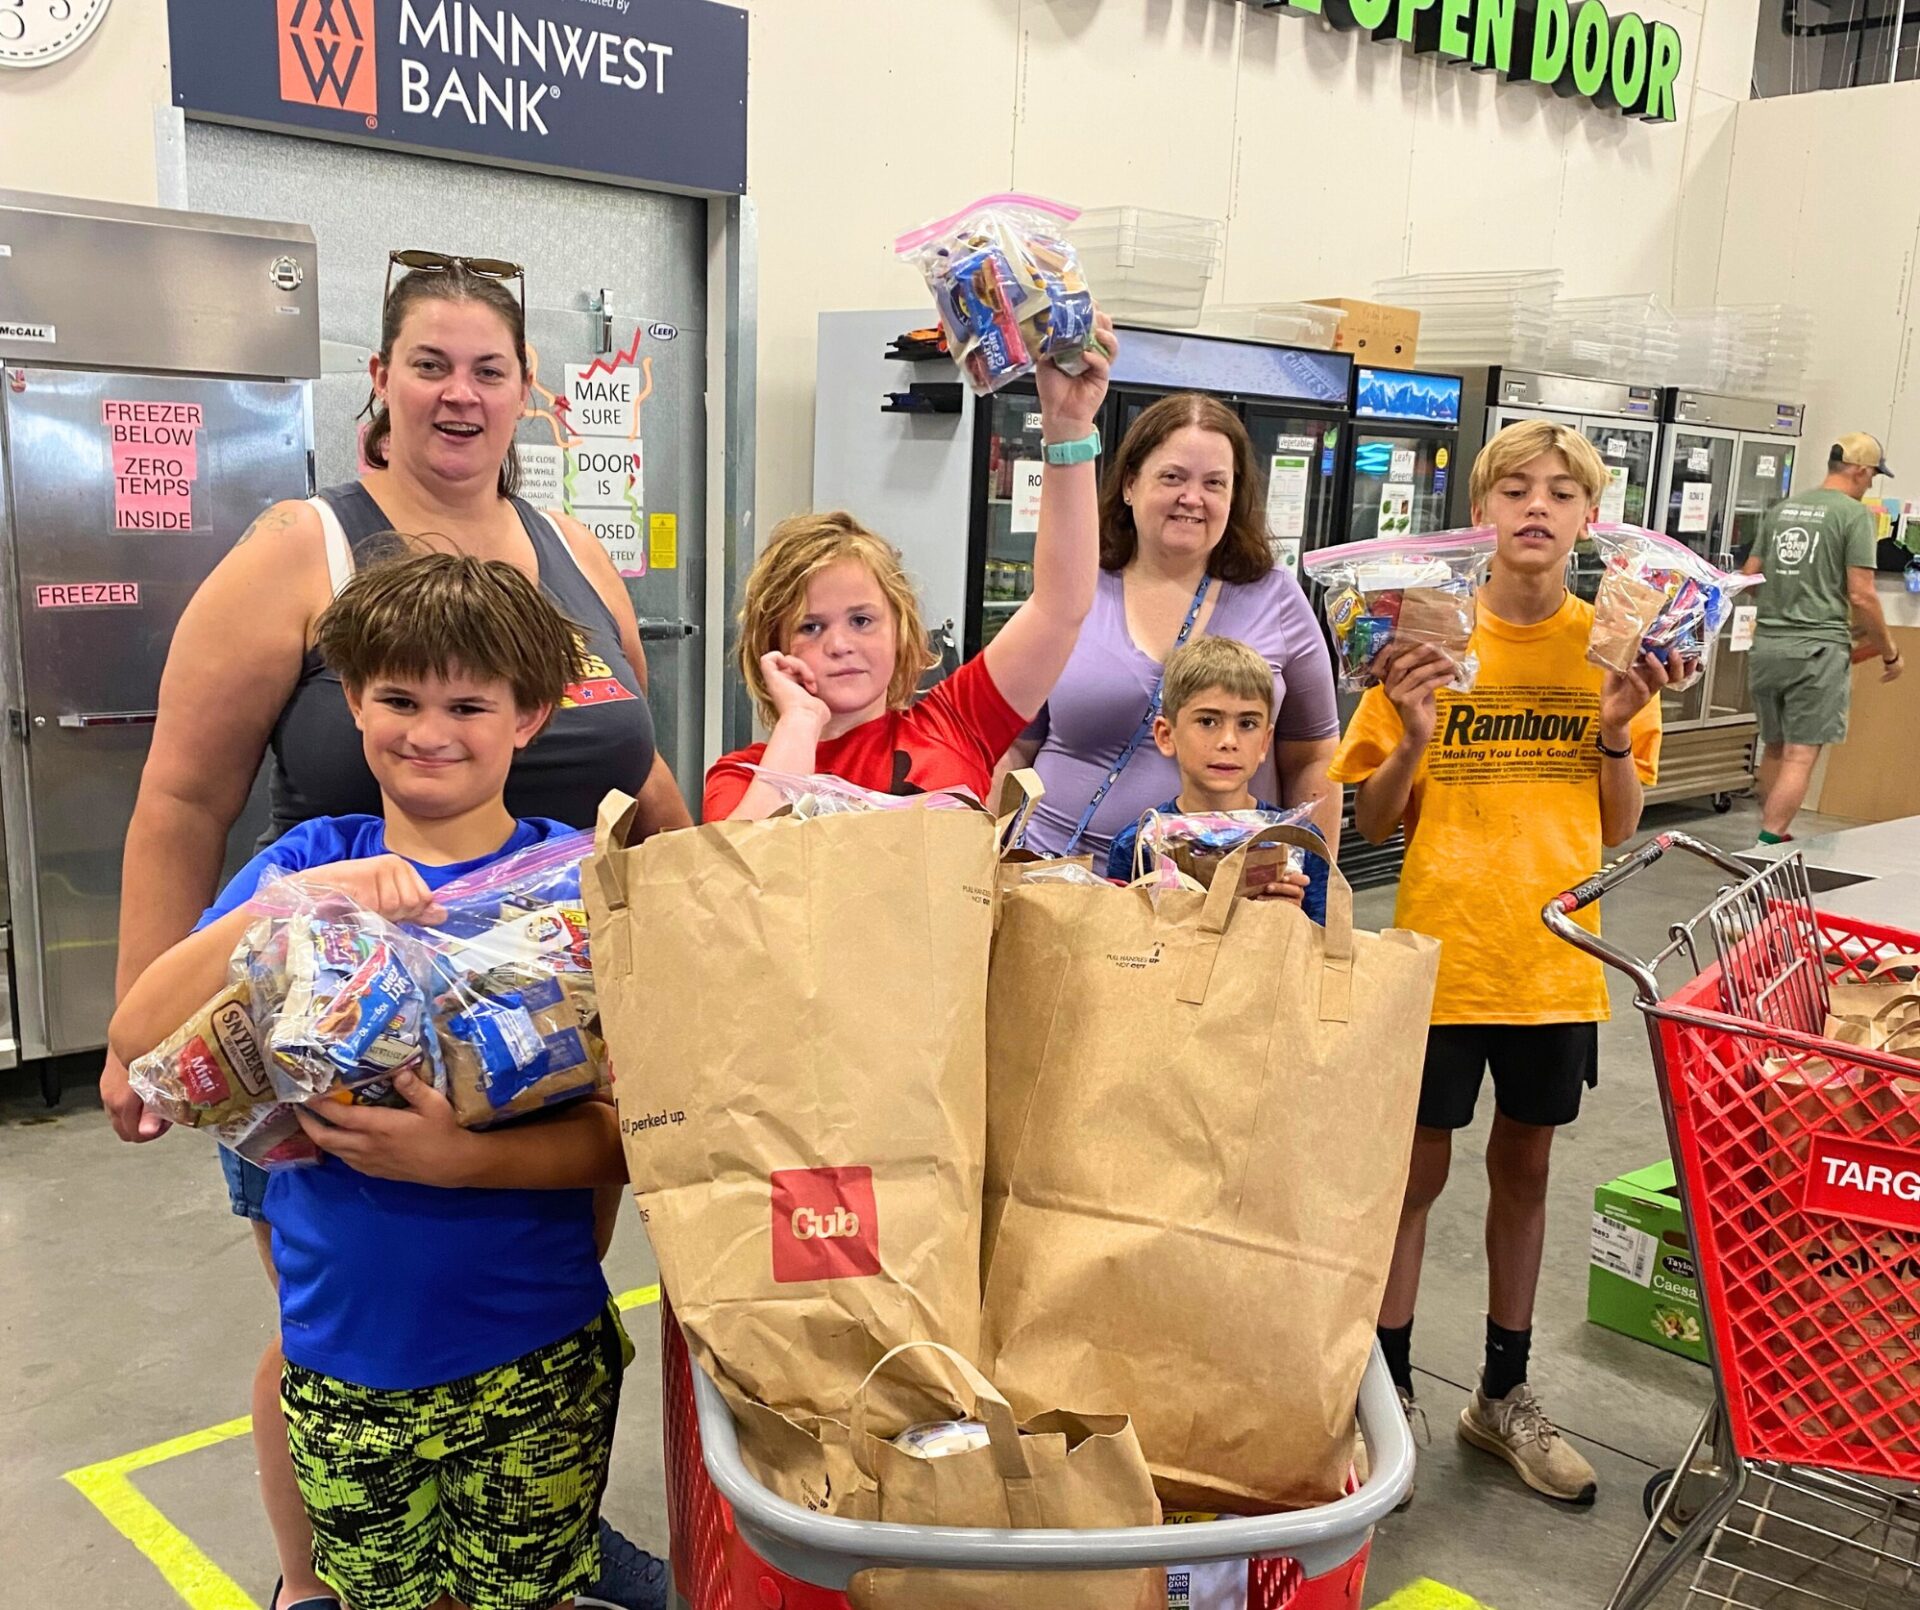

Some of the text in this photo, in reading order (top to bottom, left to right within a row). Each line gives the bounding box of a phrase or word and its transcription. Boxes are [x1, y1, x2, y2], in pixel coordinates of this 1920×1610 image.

[617, 0, 630, 14] By
[400, 0, 674, 95] MINNWEST
[1530, 0, 1682, 122] DOOR
[575, 381, 631, 403] MAKE
[105, 403, 201, 424] FREEZER
[582, 409, 622, 425] SURE
[114, 425, 194, 447] BELOW
[124, 457, 183, 477] ZERO
[535, 456, 556, 464] CLOSE
[578, 453, 634, 473] DOOR
[116, 477, 190, 497] TEMPS
[597, 480, 611, 495] IS
[117, 510, 191, 529] INSIDE
[583, 524, 635, 539] OSED
[37, 584, 137, 606] FREEZER
[1443, 704, 1590, 746] Rambow
[1442, 747, 1578, 761] Making You Look Good!
[631, 1110, 668, 1136] perked
[669, 1109, 687, 1126] up.
[791, 1205, 860, 1240] Cub
[1653, 1274, 1699, 1301] Caesa
[1167, 1580, 1189, 1588] GMO
